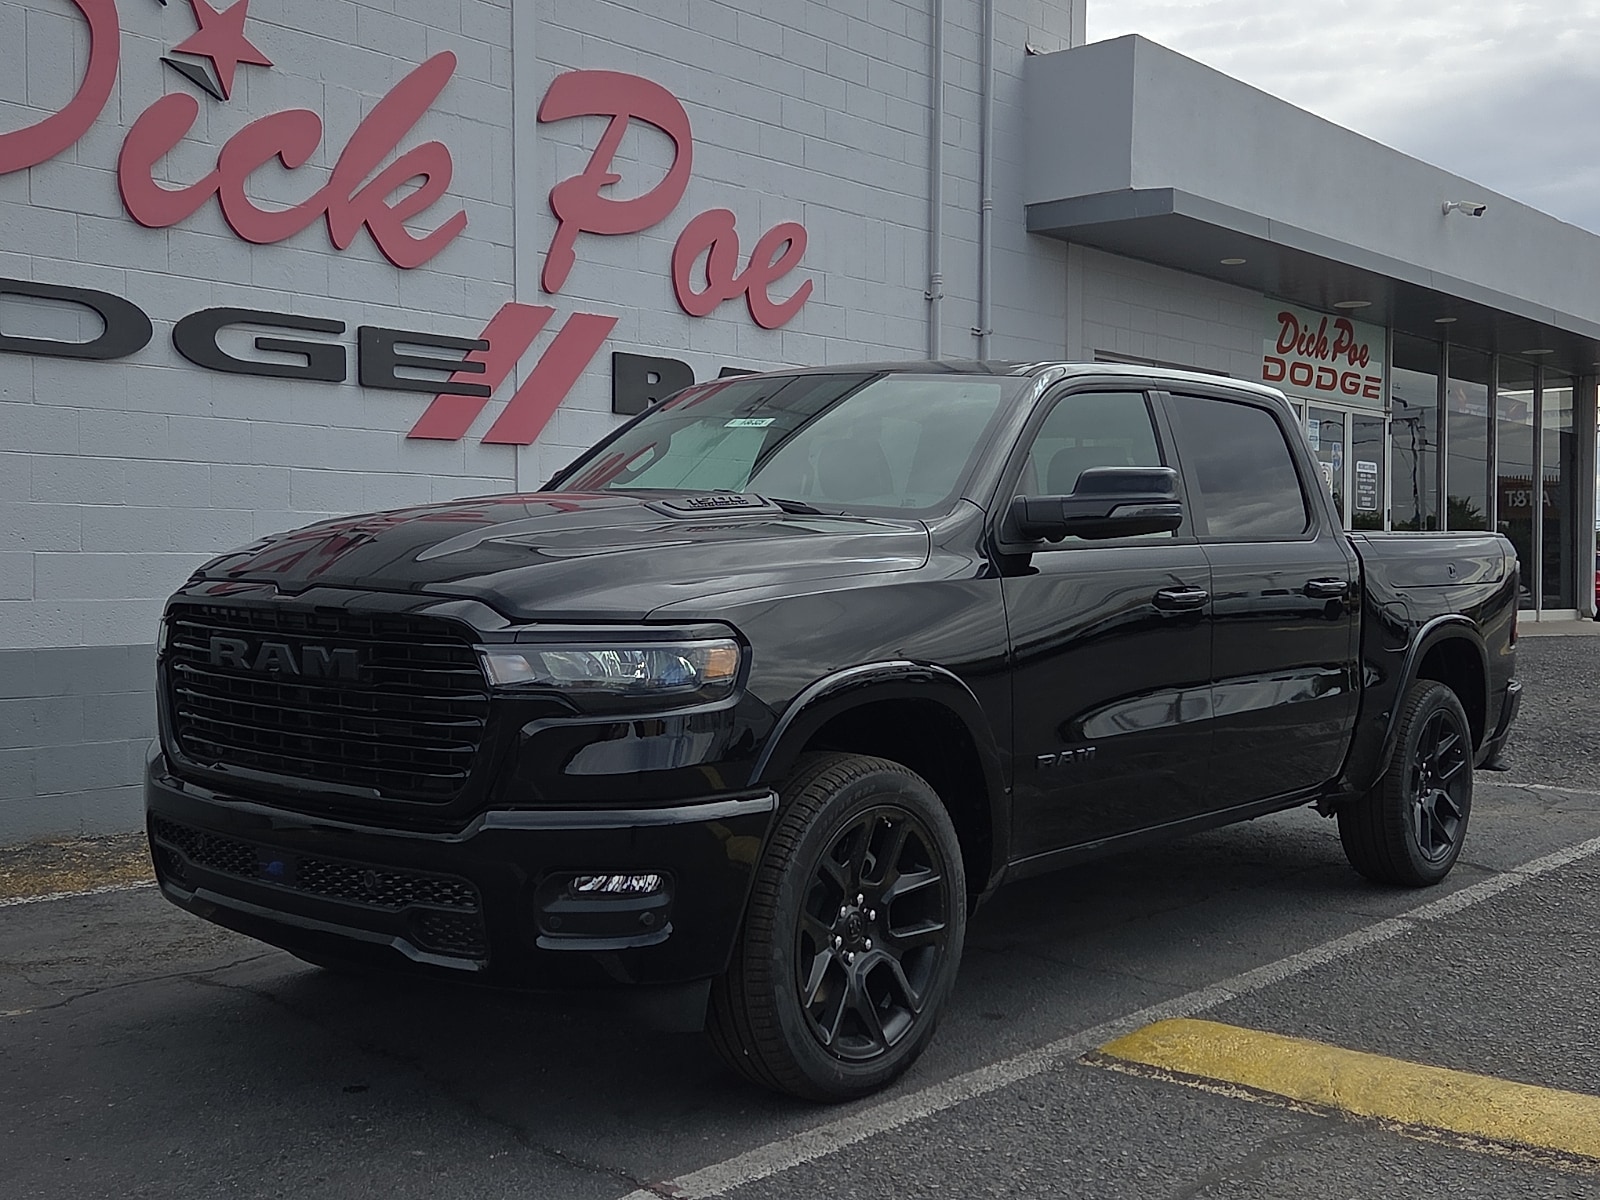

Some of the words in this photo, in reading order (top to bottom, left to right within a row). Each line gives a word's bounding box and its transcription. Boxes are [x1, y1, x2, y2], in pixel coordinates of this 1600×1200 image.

[537, 69, 813, 329] Poe
[1276, 311, 1329, 360] Dick
[1331, 318, 1369, 368] Poe
[1262, 355, 1382, 399] DODGE
[209, 636, 360, 681] RAM
[1035, 746, 1096, 770] RAM
